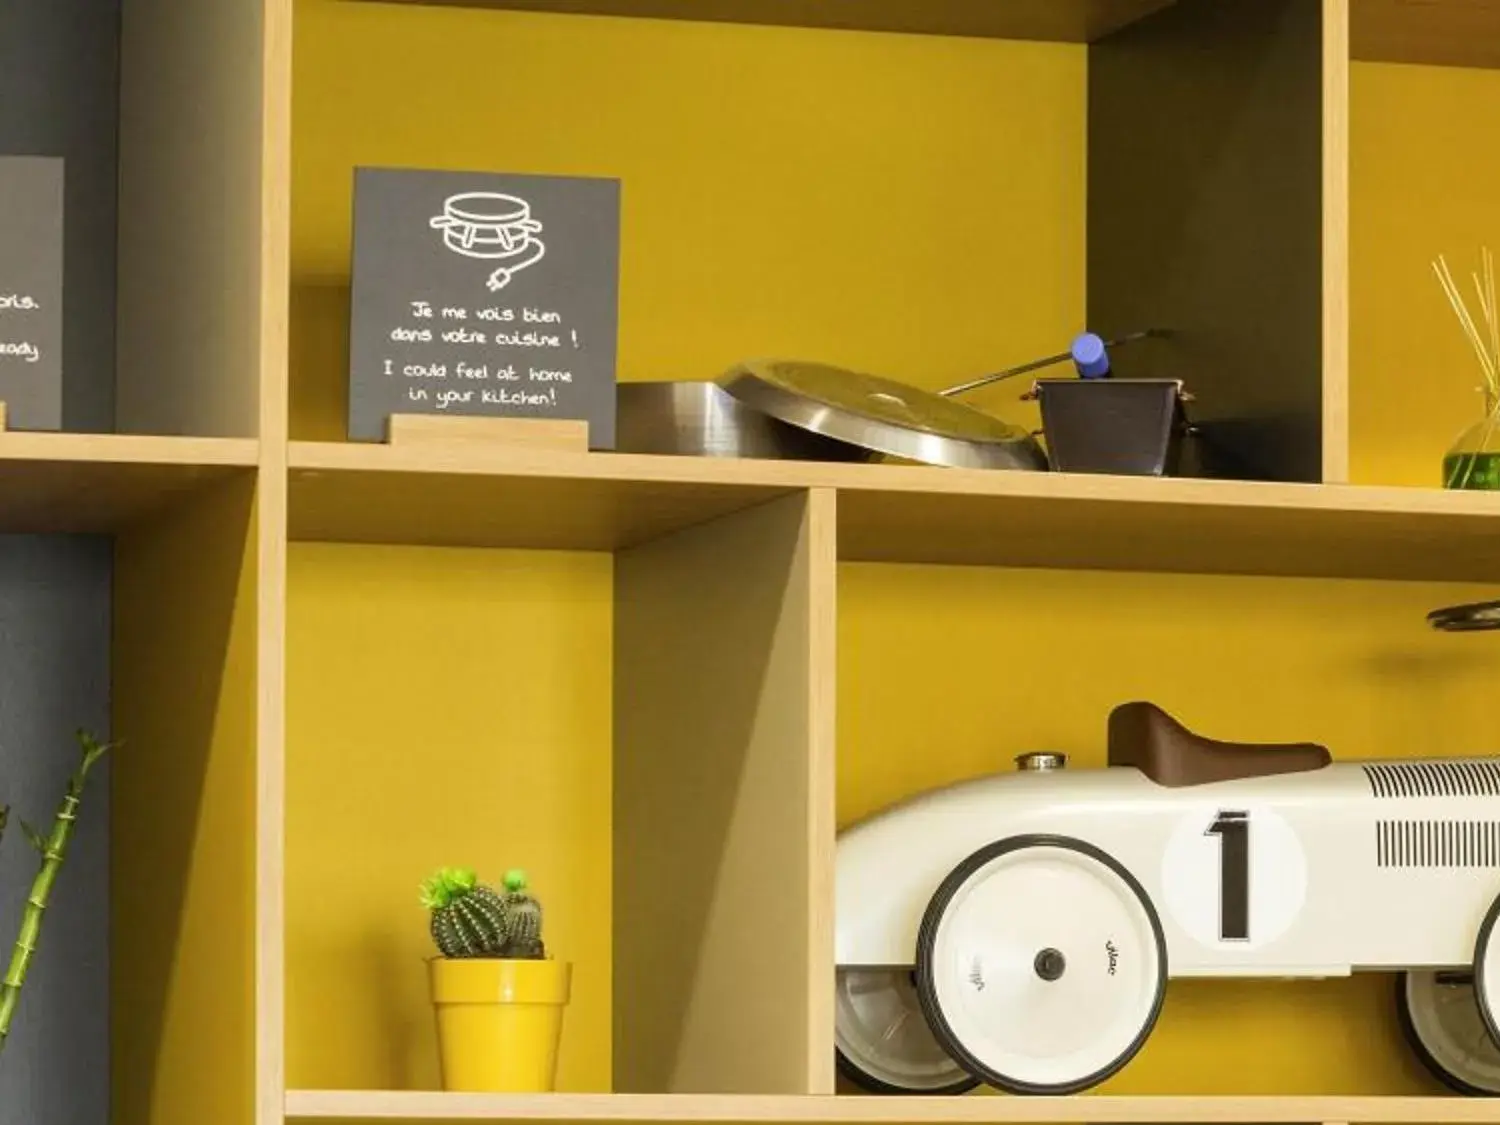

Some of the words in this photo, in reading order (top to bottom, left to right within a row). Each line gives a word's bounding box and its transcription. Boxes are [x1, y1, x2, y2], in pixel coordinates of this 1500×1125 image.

[411, 301, 433, 319] Je
[442, 307, 467, 320] me
[476, 307, 515, 321] vois
[523, 307, 561, 324] bien
[390, 327, 433, 342] dans
[442, 327, 487, 344] votre
[495, 331, 561, 346] cuisine
[384, 359, 393, 375] I
[403, 362, 447, 377] could
[456, 362, 488, 380] feel
[497, 365, 520, 381] at
[529, 367, 573, 383] home
[409, 387, 428, 400] in
[436, 389, 475, 409] your
[482, 388, 557, 407] kitchen!
[1204, 811, 1251, 942] 1
